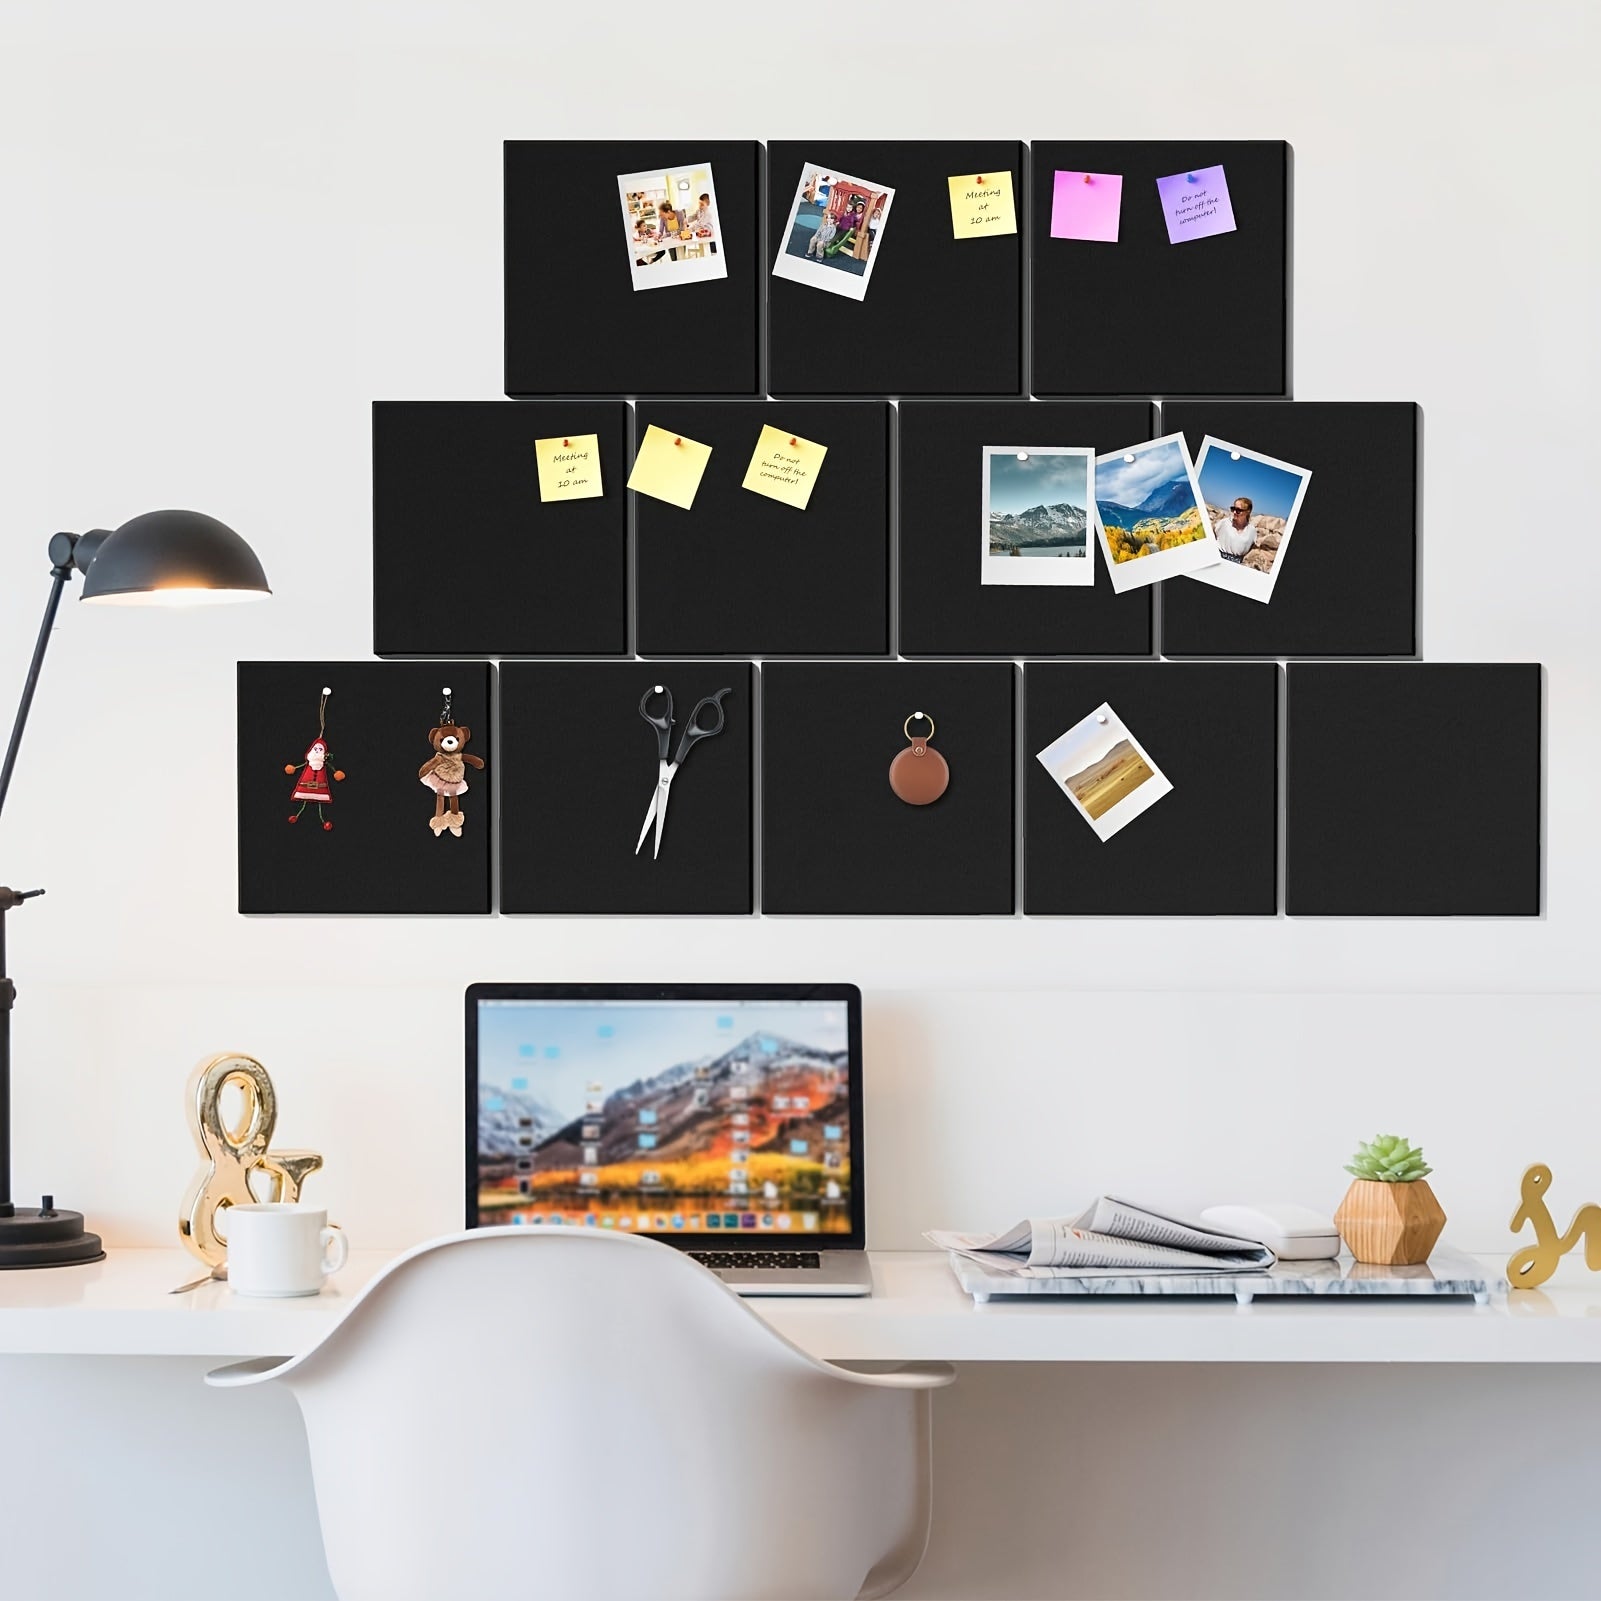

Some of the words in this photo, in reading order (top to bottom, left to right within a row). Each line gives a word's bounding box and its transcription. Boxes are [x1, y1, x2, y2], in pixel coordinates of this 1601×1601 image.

[966, 188, 1001, 200] Meeting
[1195, 189, 1207, 199] not
[978, 203, 990, 211] at
[1175, 206, 1193, 216] turn
[1195, 201, 1206, 211] off
[1207, 197, 1219, 205] the
[970, 217, 983, 225] 10
[985, 215, 1001, 223] am
[1179, 207, 1217, 225] computer!
[553, 452, 589, 463] Meeting
[773, 453, 785, 461] Do
[565, 466, 577, 474] at
[761, 460, 781, 470] turn
[780, 466, 794, 475] off
[794, 468, 807, 477] the
[759, 471, 799, 485] computer!
[558, 479, 570, 488] 10
